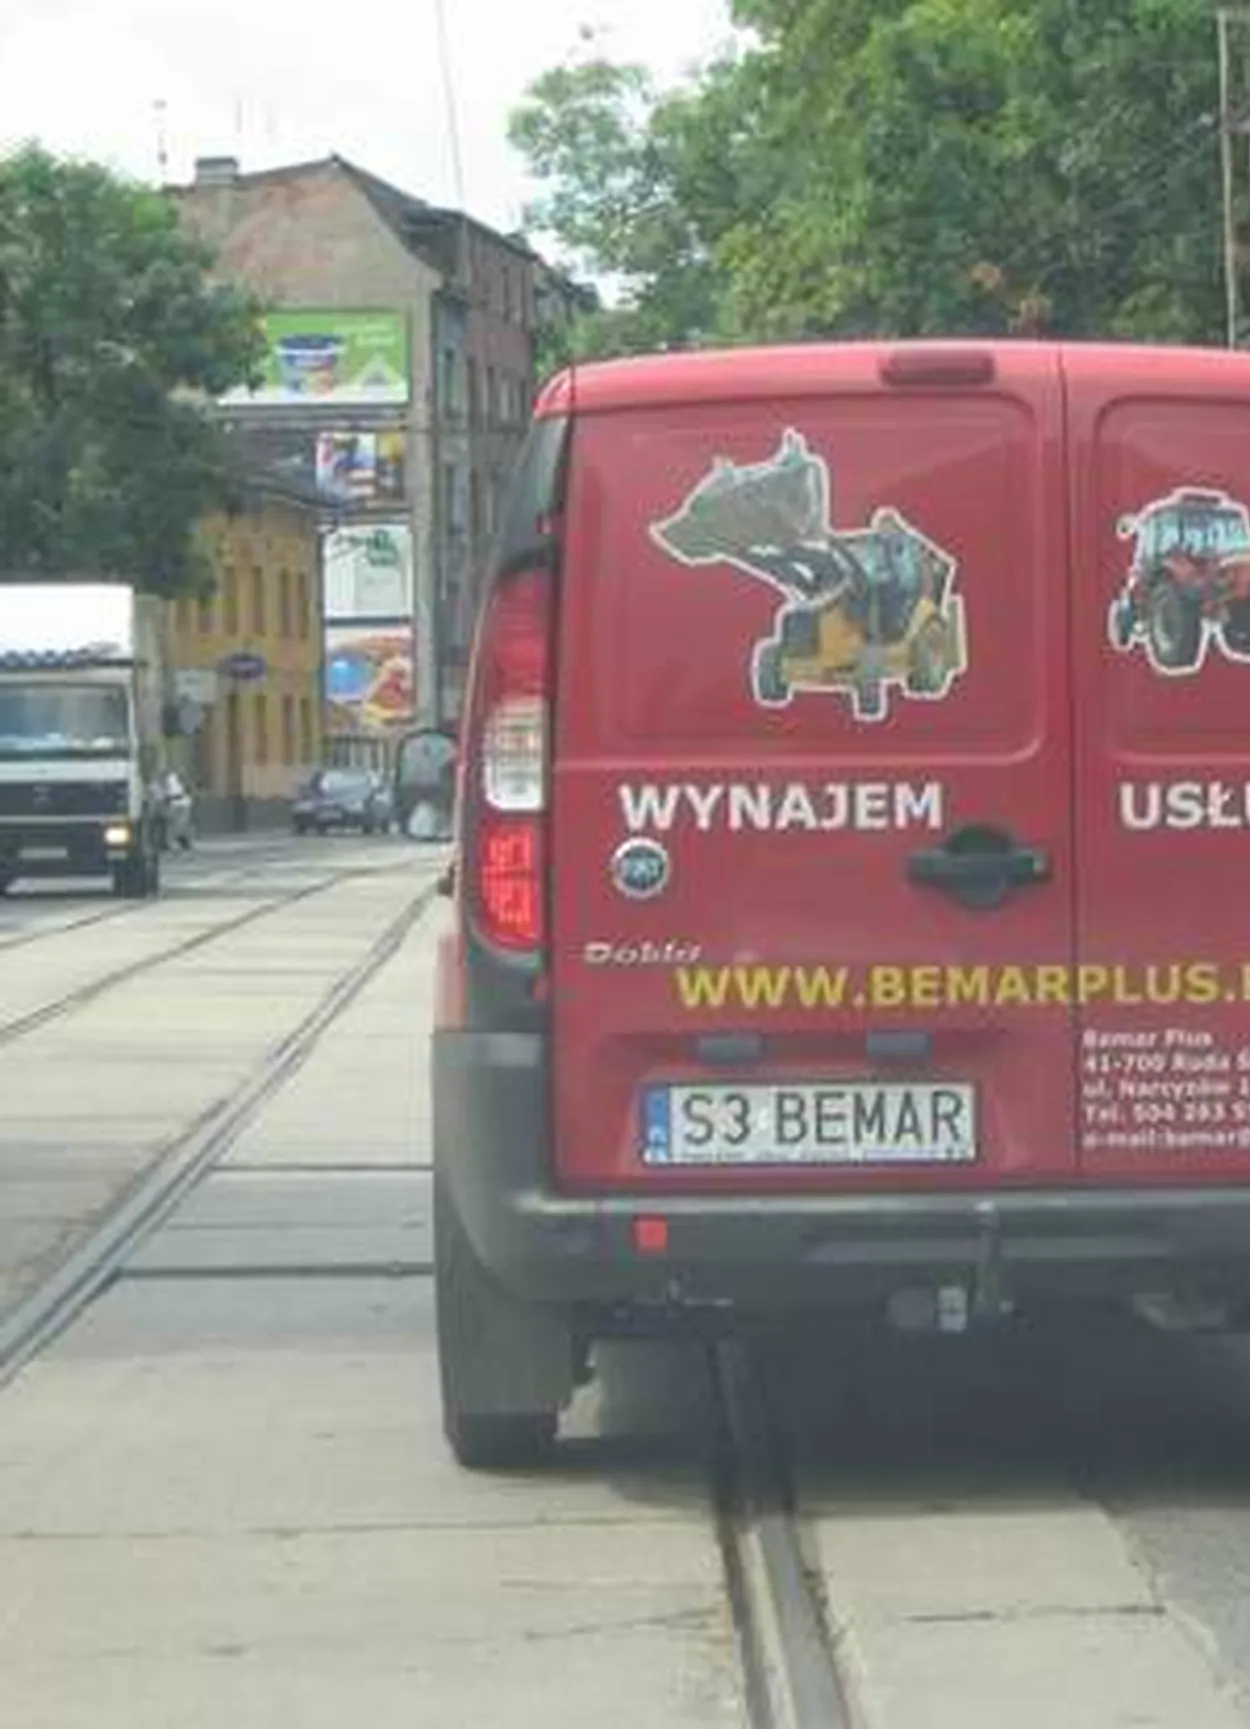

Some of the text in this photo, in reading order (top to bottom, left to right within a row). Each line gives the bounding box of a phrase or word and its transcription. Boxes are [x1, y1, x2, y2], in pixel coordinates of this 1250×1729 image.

[618, 783, 943, 831] WYNAJEM
[682, 1093, 751, 1146] S3
[775, 1090, 964, 1145] BEMAR
